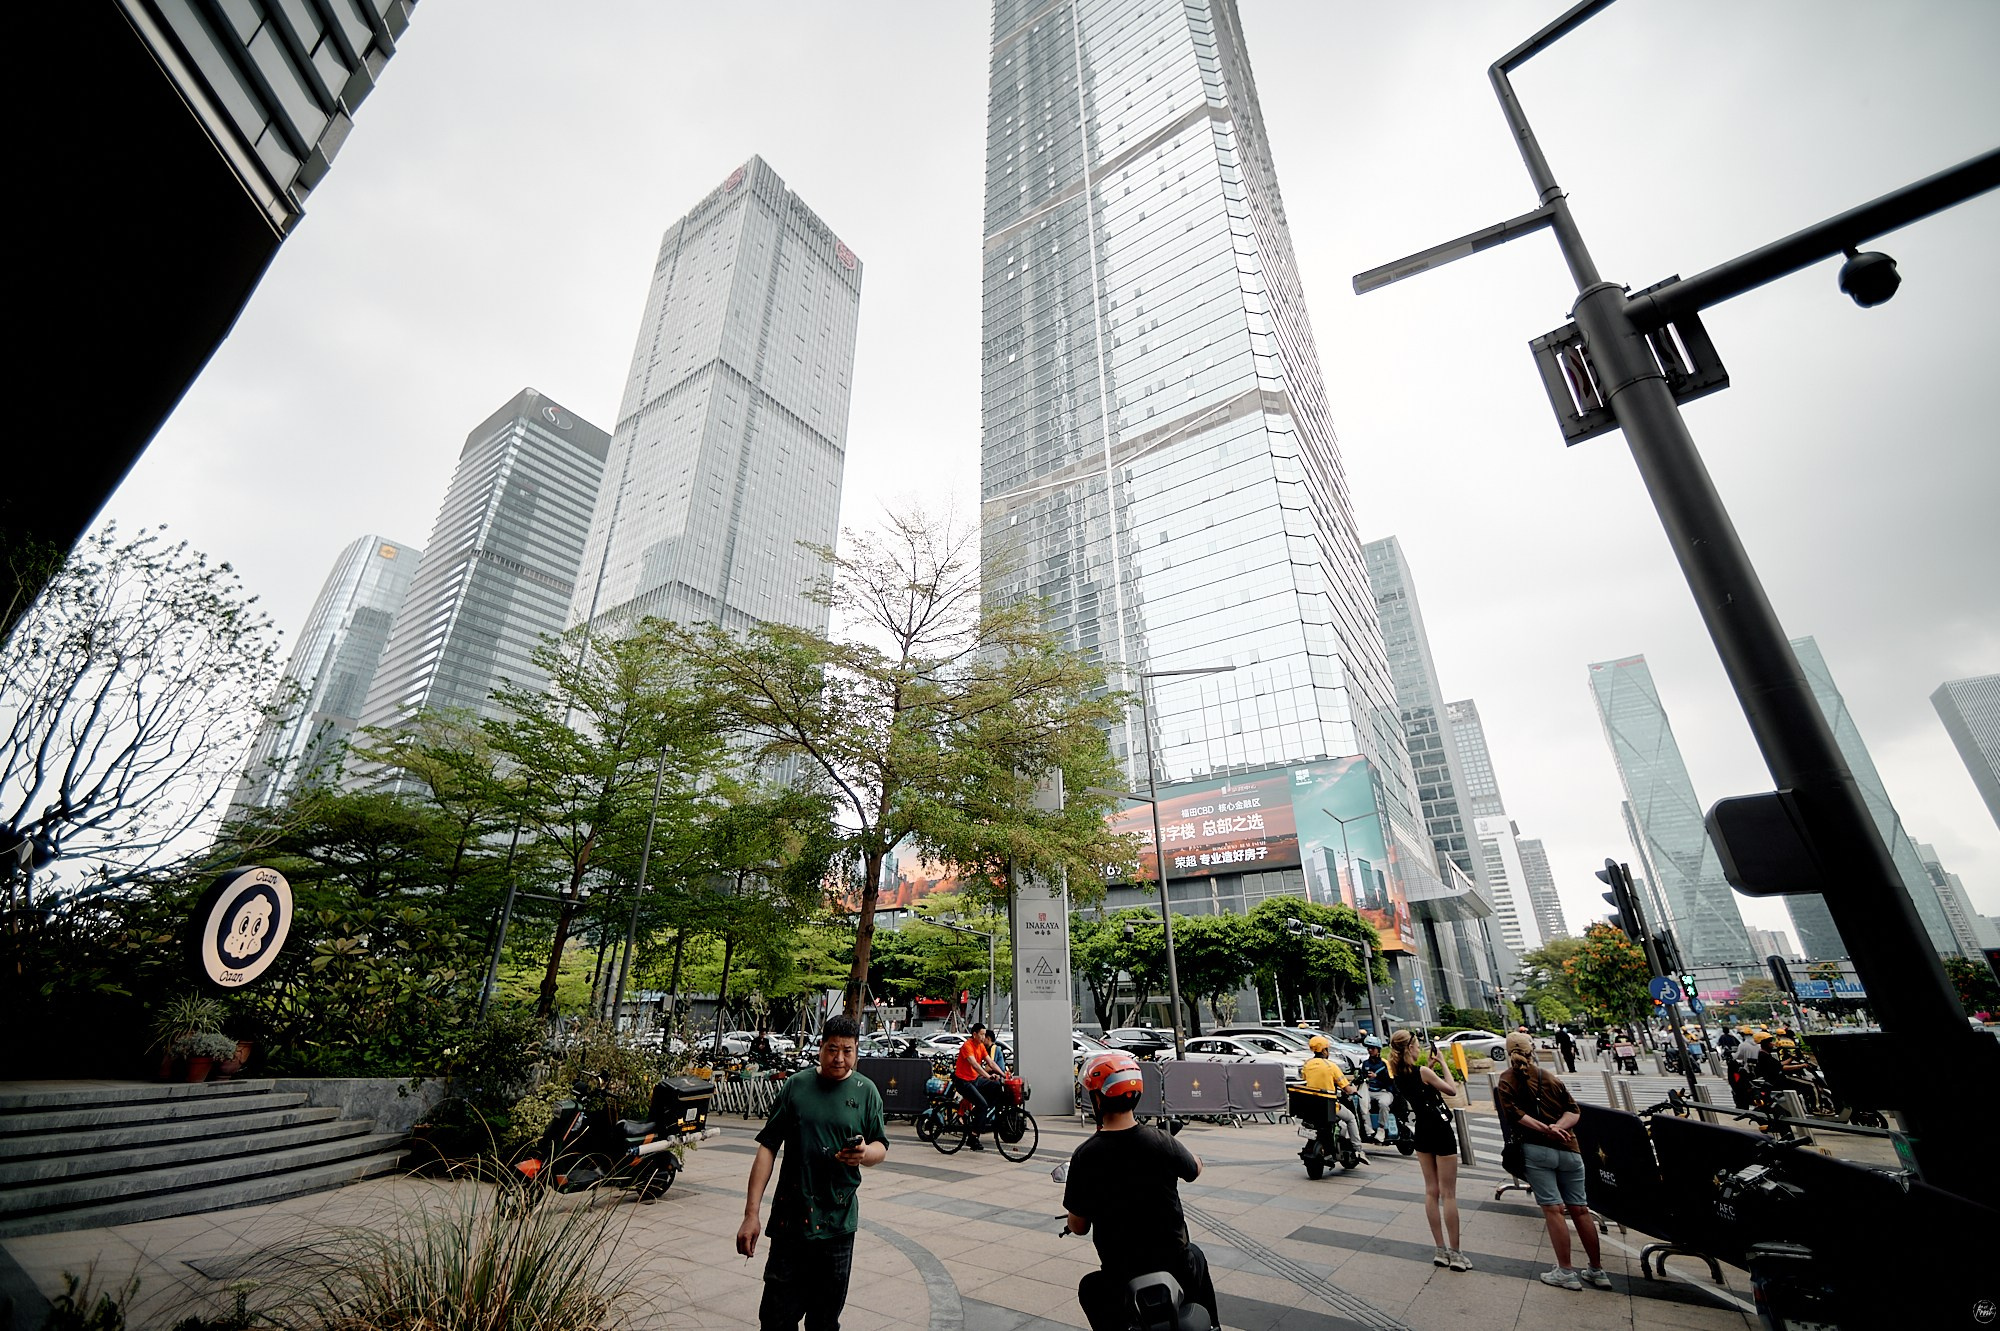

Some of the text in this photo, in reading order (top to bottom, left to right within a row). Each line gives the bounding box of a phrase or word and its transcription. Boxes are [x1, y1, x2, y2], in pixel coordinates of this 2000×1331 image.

[1181, 797, 1261, 818] 福田CBD 核心金融区
[1202, 813, 1264, 837] 总部之选
[1174, 846, 1268, 869] 荣超 专业造好房子
[1026, 922, 1060, 930] INAKAYA
[1600, 1169, 1616, 1182] PAFC
